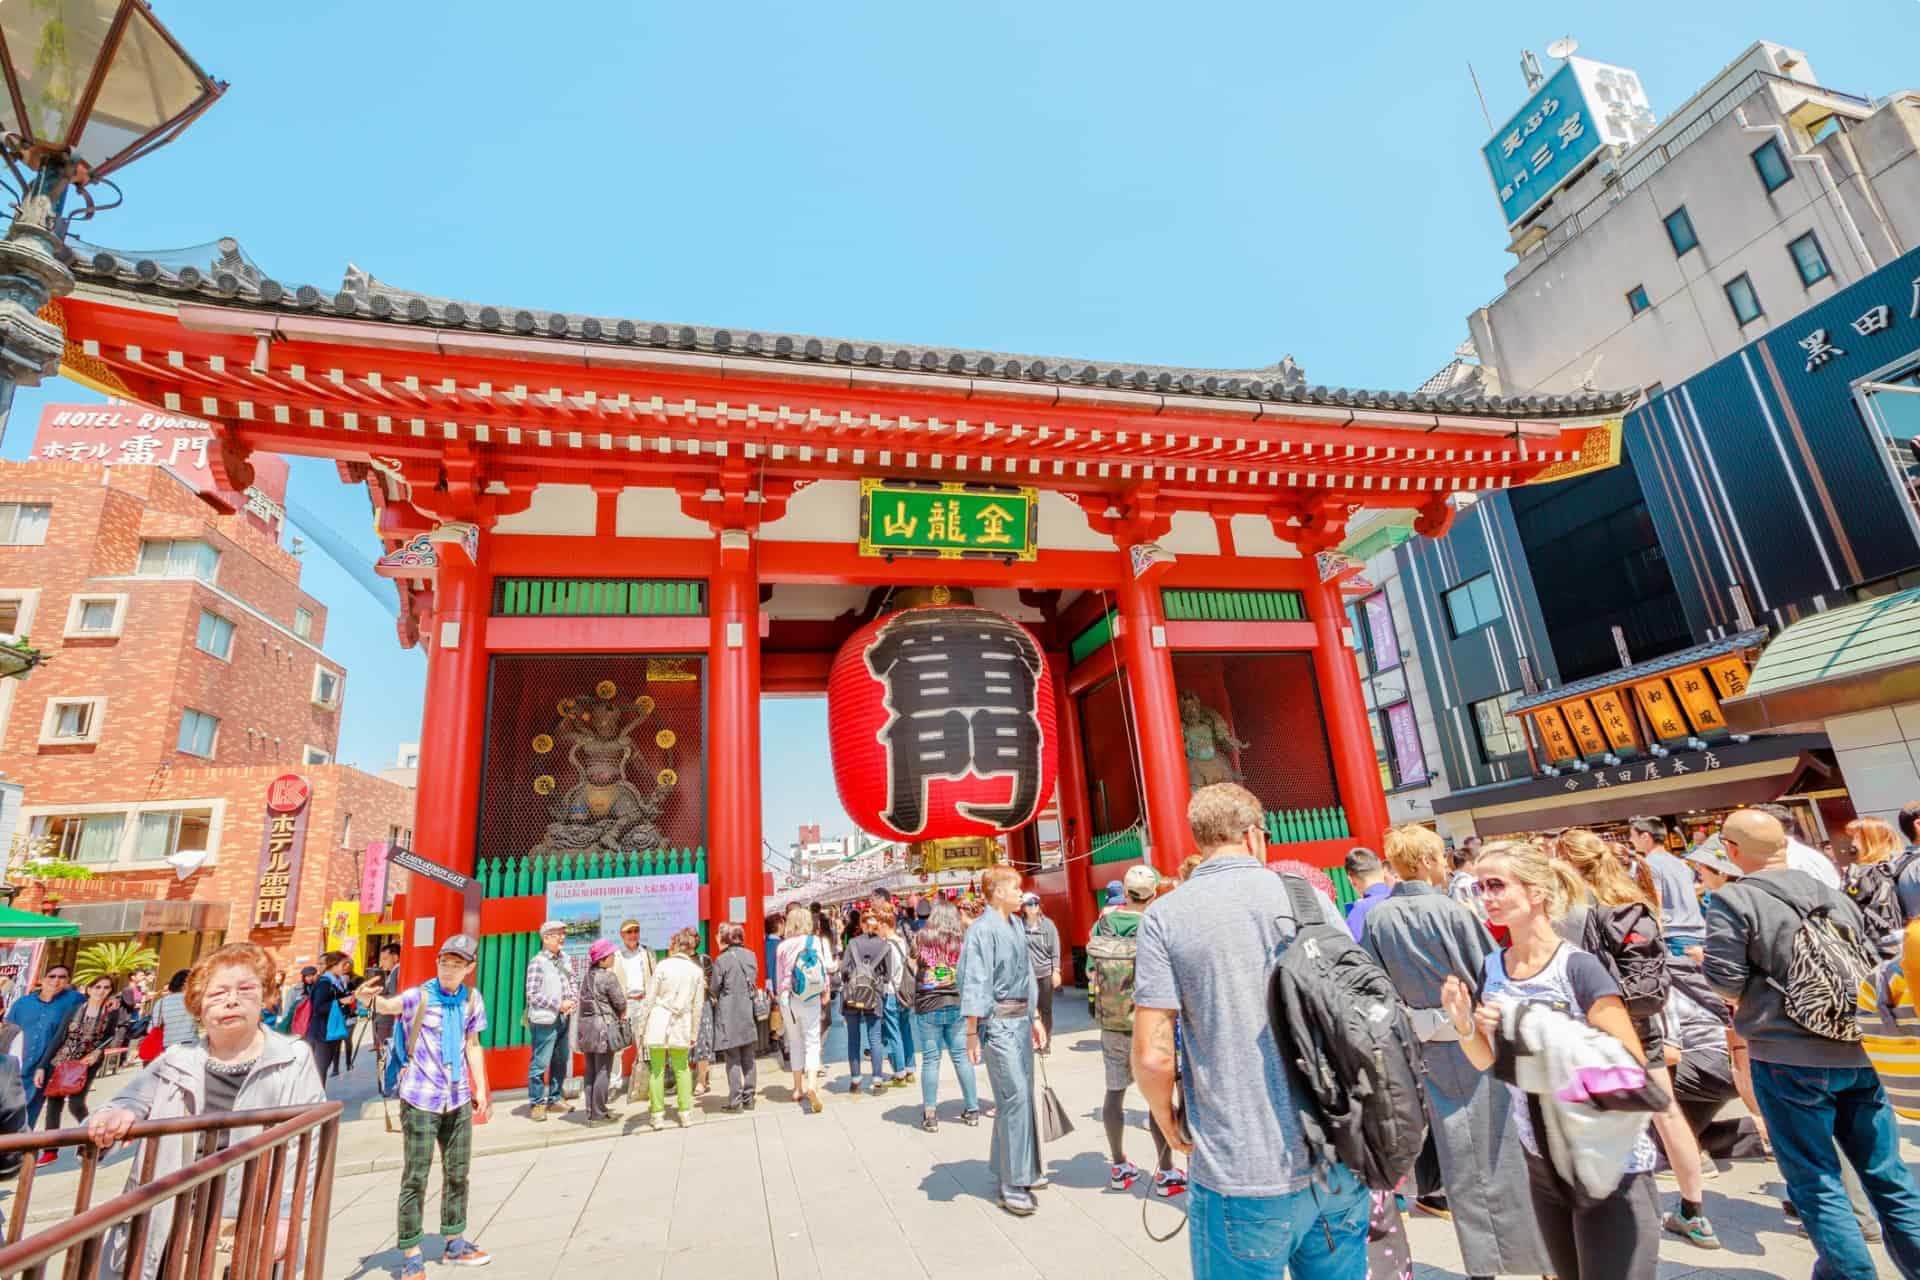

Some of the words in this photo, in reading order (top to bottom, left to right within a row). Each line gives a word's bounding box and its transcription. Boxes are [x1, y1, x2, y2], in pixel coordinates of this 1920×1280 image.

[1503, 98, 1559, 159] 天ぷら
[52, 410, 122, 429] HOTEL
[136, 412, 210, 432] Ryokan
[864, 607, 1044, 834] 雷門
[1594, 751, 1721, 789] 黒田屋本店
[254, 813, 296, 927] ホテル雷門
